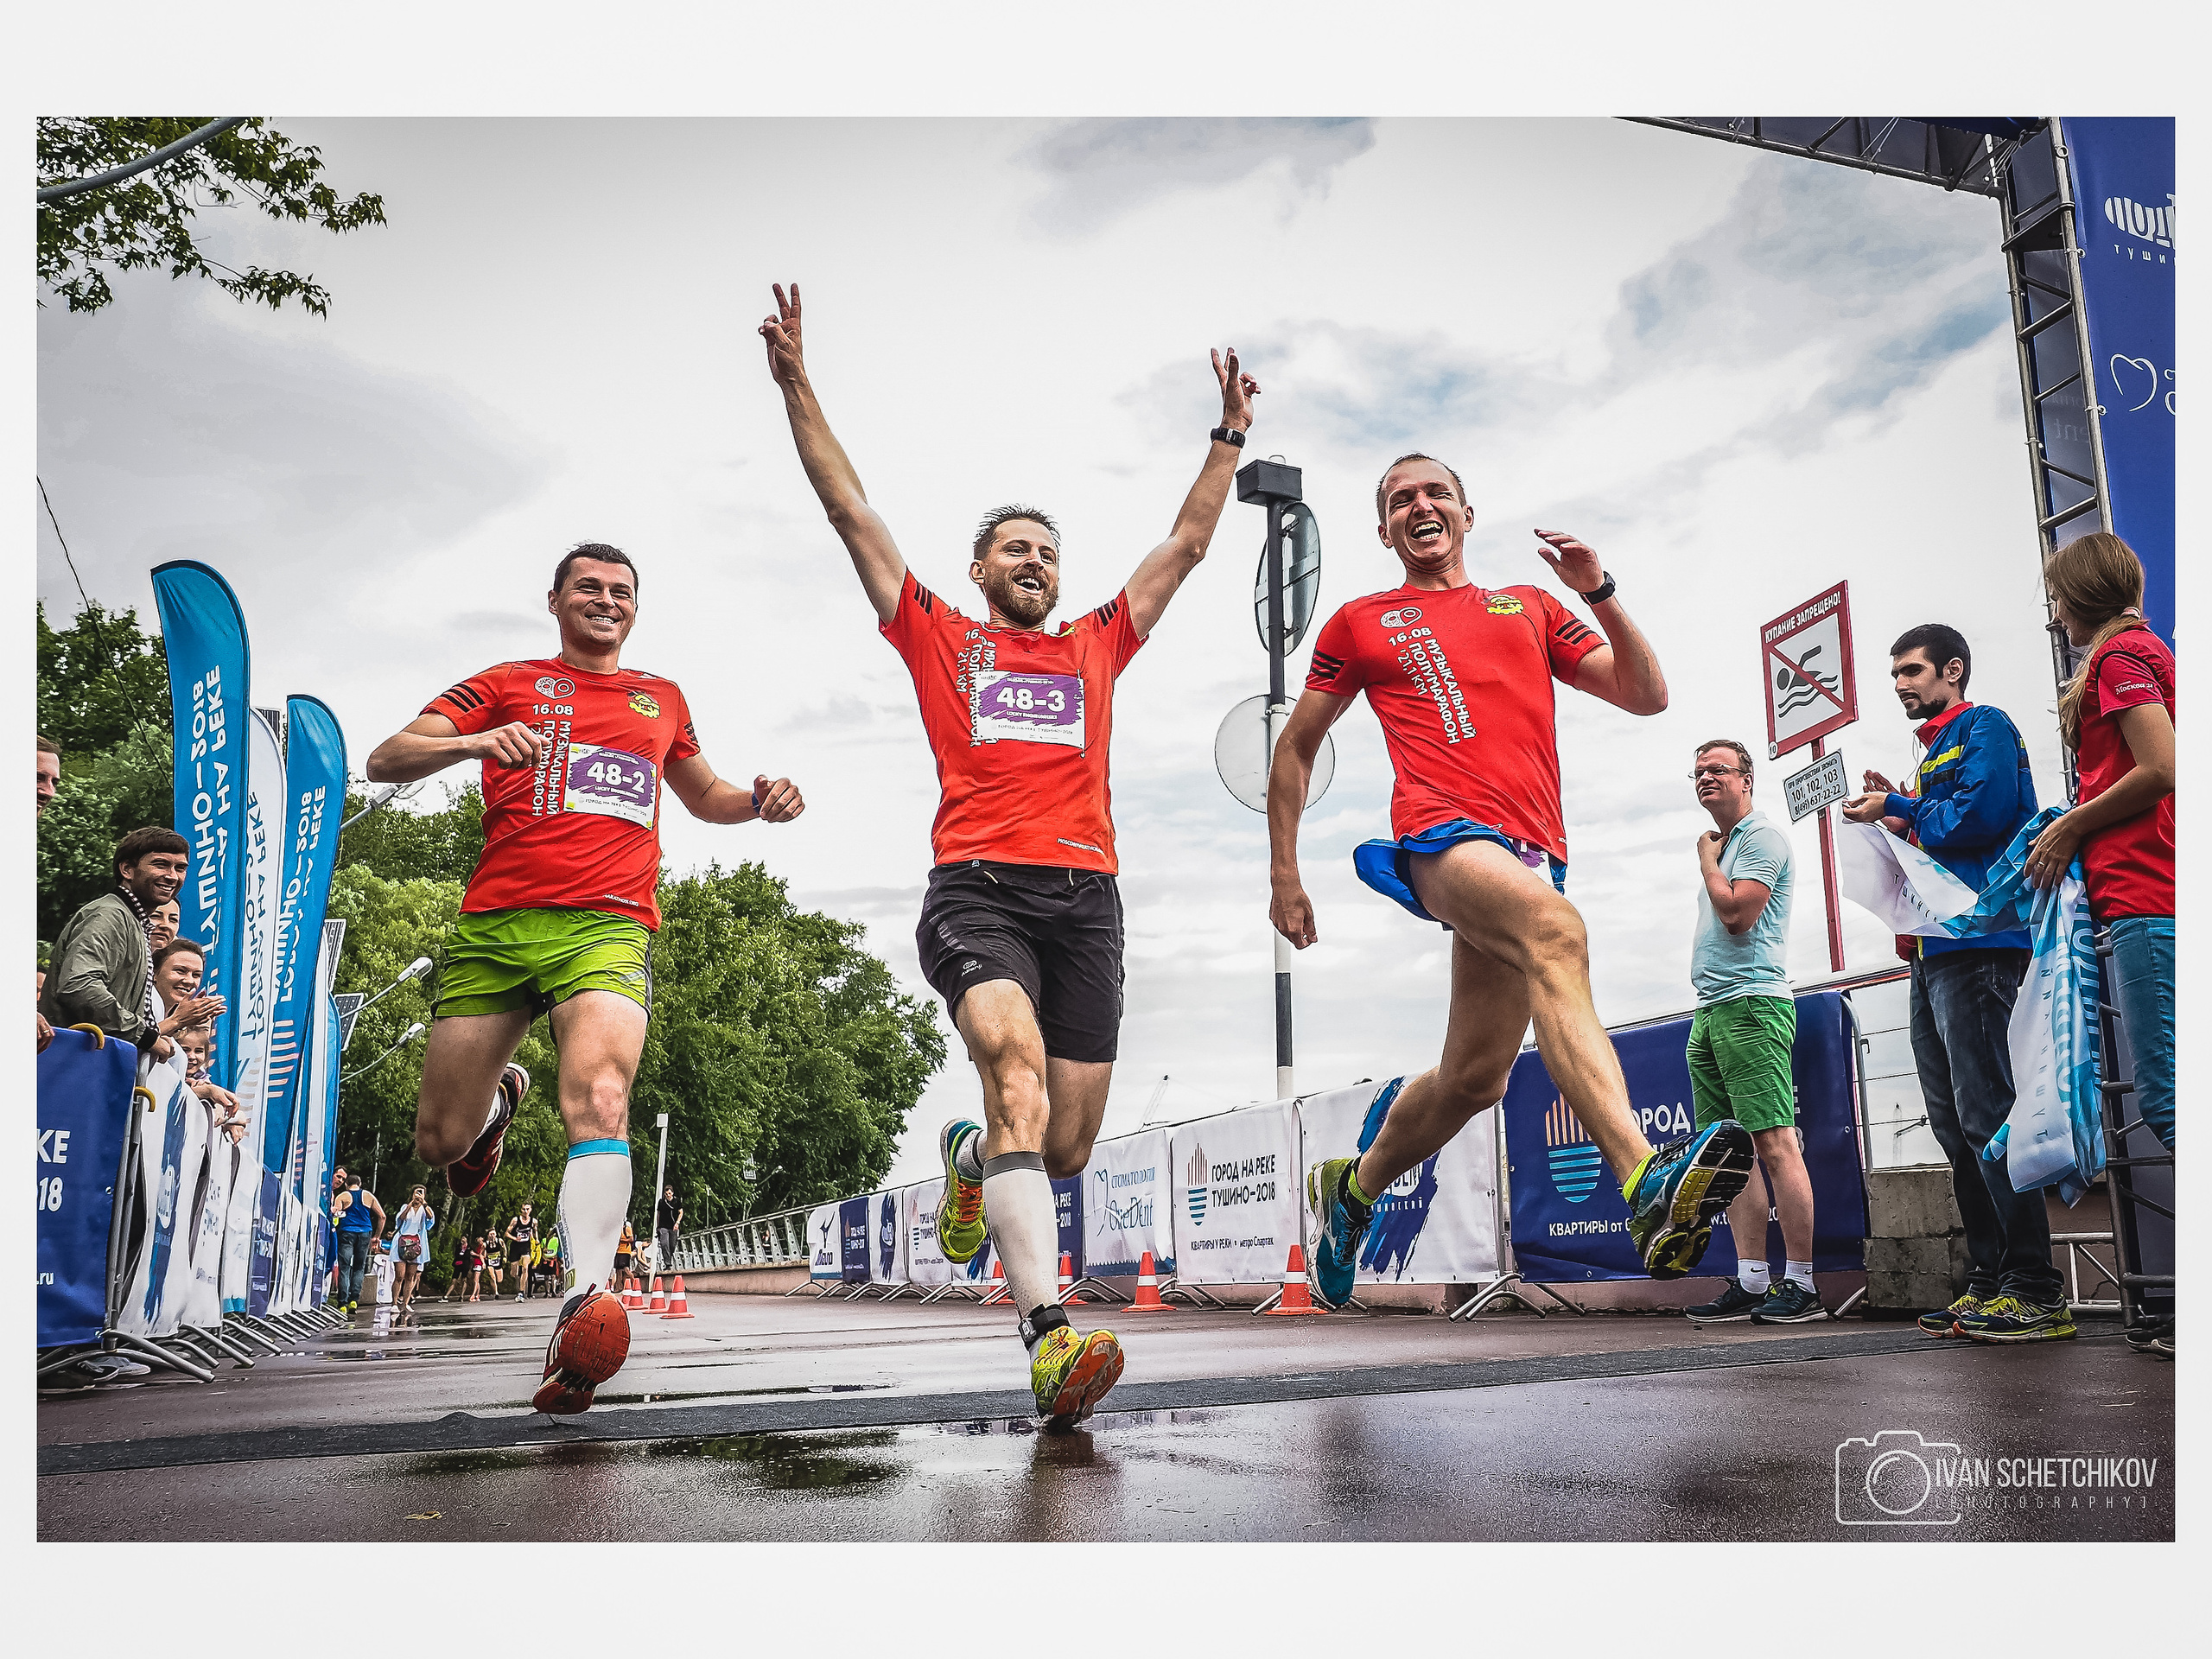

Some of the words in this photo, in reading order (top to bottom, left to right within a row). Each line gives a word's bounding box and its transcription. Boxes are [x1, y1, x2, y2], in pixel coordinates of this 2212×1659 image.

[2113, 244, 2176, 266] ТУШИ
[1764, 616, 1796, 644] КУПАНИЕ
[1796, 590, 1841, 626] ЗАПРЕЩЕНО!
[1388, 626, 1433, 646] 16.08
[996, 686, 1066, 713] 48-3
[1408, 642, 1461, 745] ПОЛУМАРАФОН
[1424, 638, 1477, 739] МУЗЫКАЛЬНЫЙ
[532, 703, 574, 716] 16.08
[546, 721, 572, 815] МУЗЫКАЛЬНЫЙ
[587, 761, 646, 794] 48-2
[1807, 778, 1823, 794] 102,
[1823, 768, 1839, 785] 103
[1810, 784, 1841, 806] 637-22-22
[1211, 1160, 1240, 1183] ГОРОД
[1241, 1159, 1254, 1179] НА
[1255, 1154, 1275, 1175] РЕКЕ
[1548, 1219, 1608, 1236] КВАРТИРЫ
[1610, 1221, 1623, 1233] от
